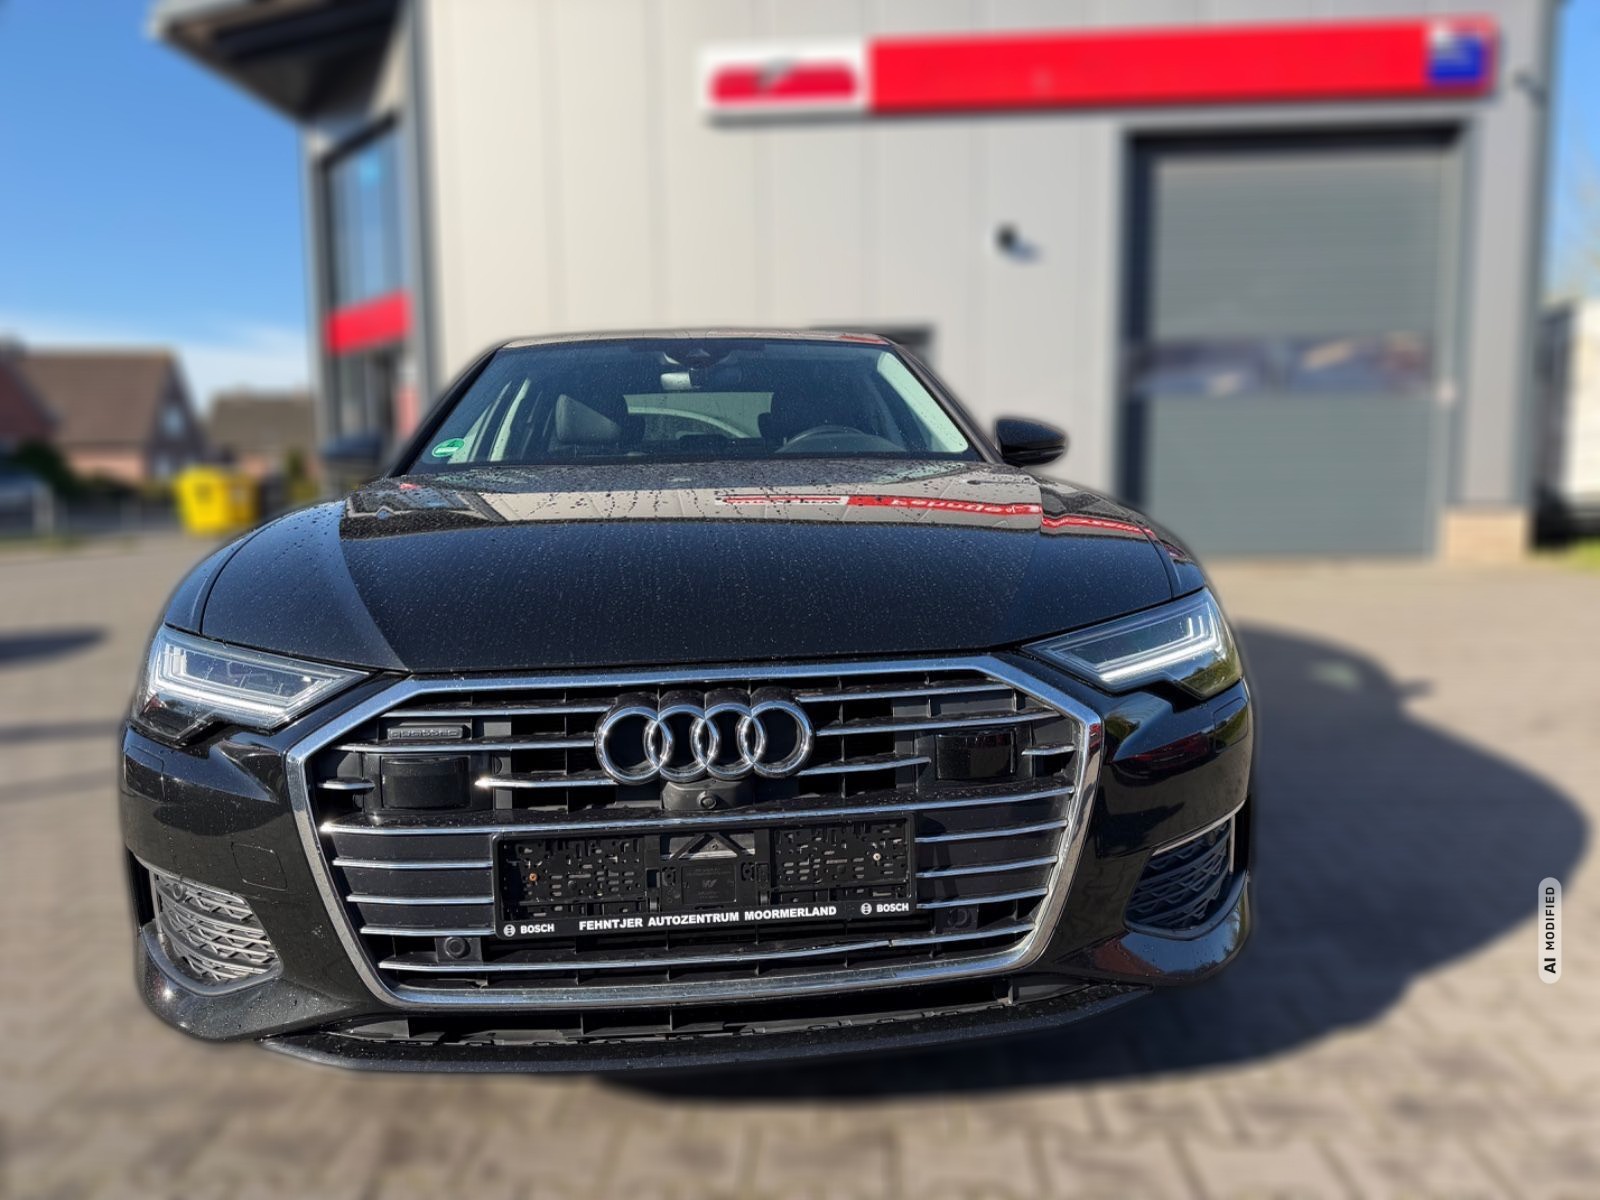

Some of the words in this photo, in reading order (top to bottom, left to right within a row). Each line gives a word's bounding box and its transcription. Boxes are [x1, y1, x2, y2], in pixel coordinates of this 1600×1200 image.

[876, 903, 909, 913] BOSCH
[579, 918, 643, 931] FEHNTJER
[648, 911, 739, 927] AUTOZENTRUM
[744, 906, 837, 921] MOORMERLAND
[520, 923, 555, 934] BOSCH
